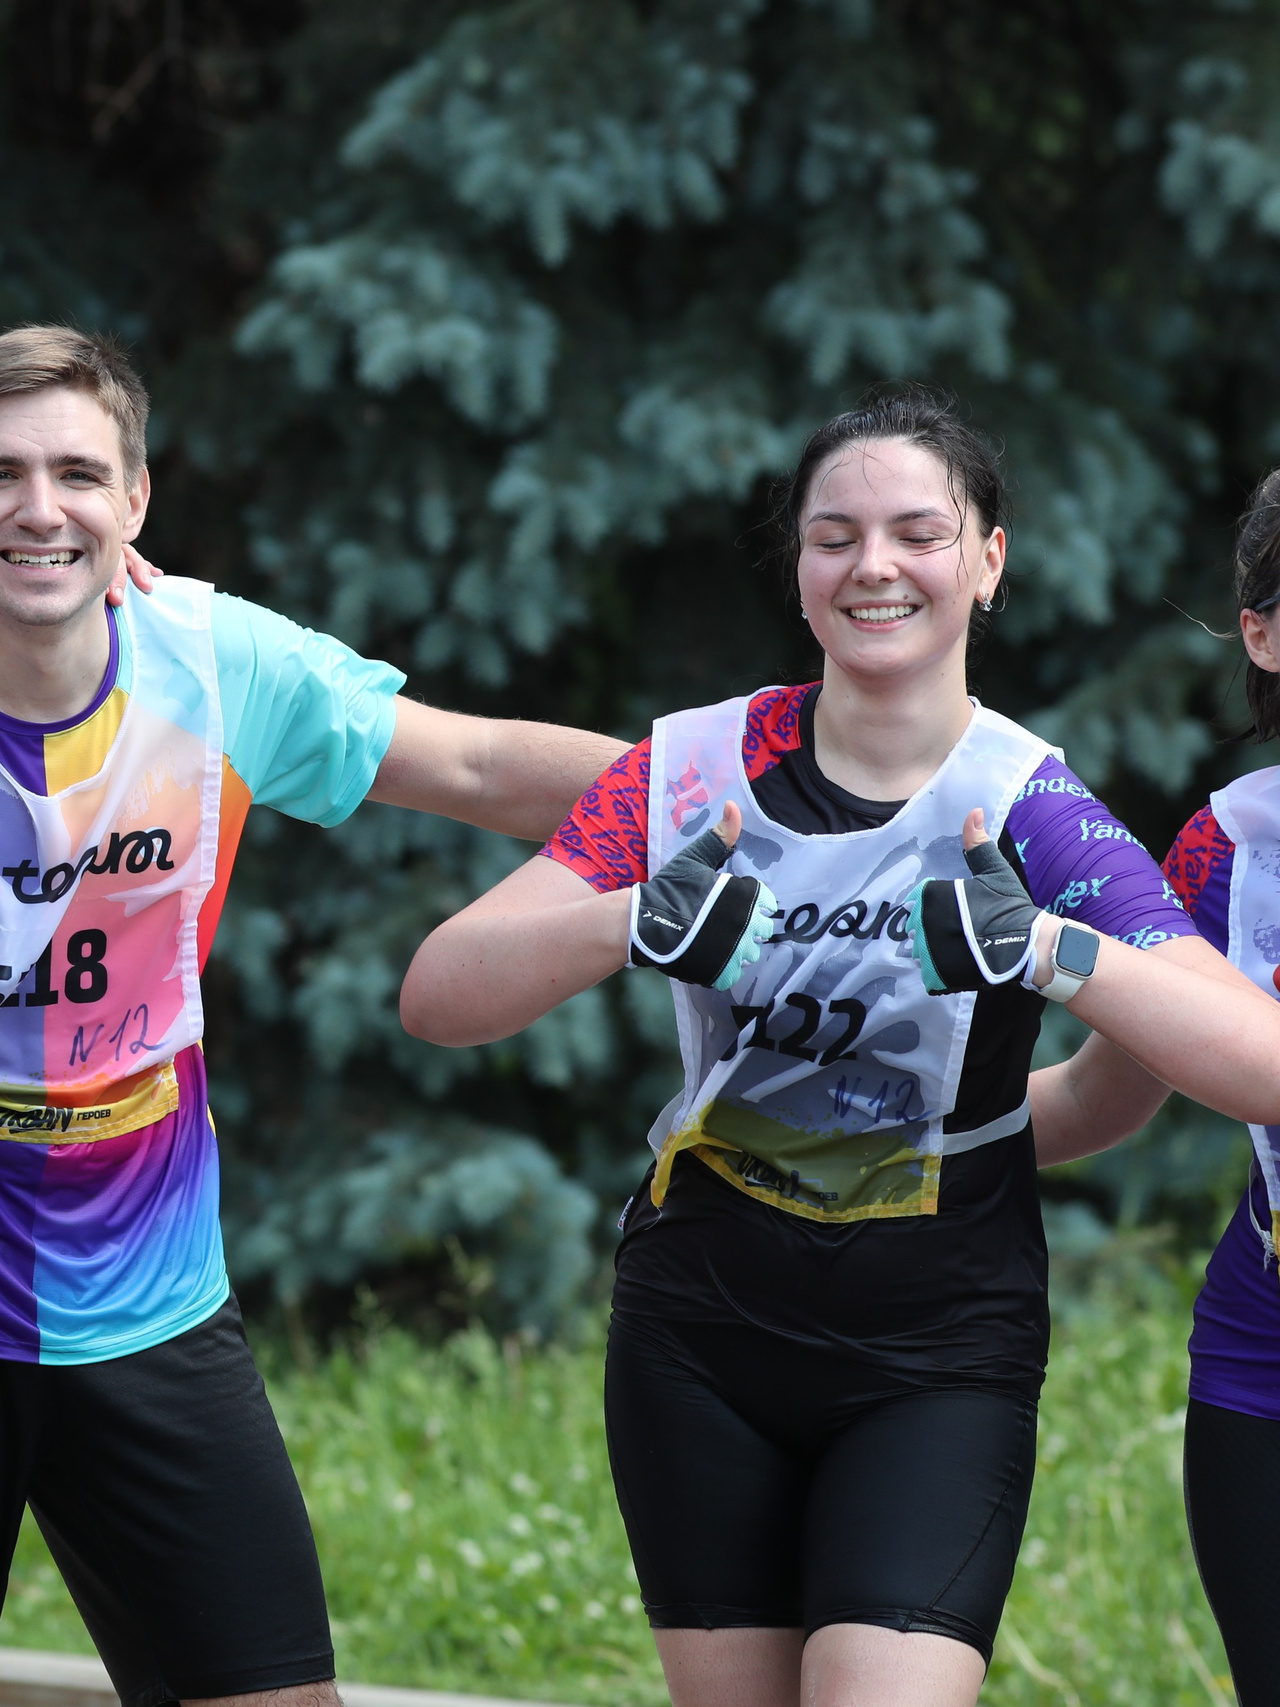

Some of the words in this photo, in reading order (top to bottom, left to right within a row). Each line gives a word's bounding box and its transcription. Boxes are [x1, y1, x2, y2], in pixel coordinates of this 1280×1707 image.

[652, 915, 685, 932] DEMIX
[994, 935, 1027, 947] DEMIX
[76, 1108, 112, 1121] ГЕРОЕВ
